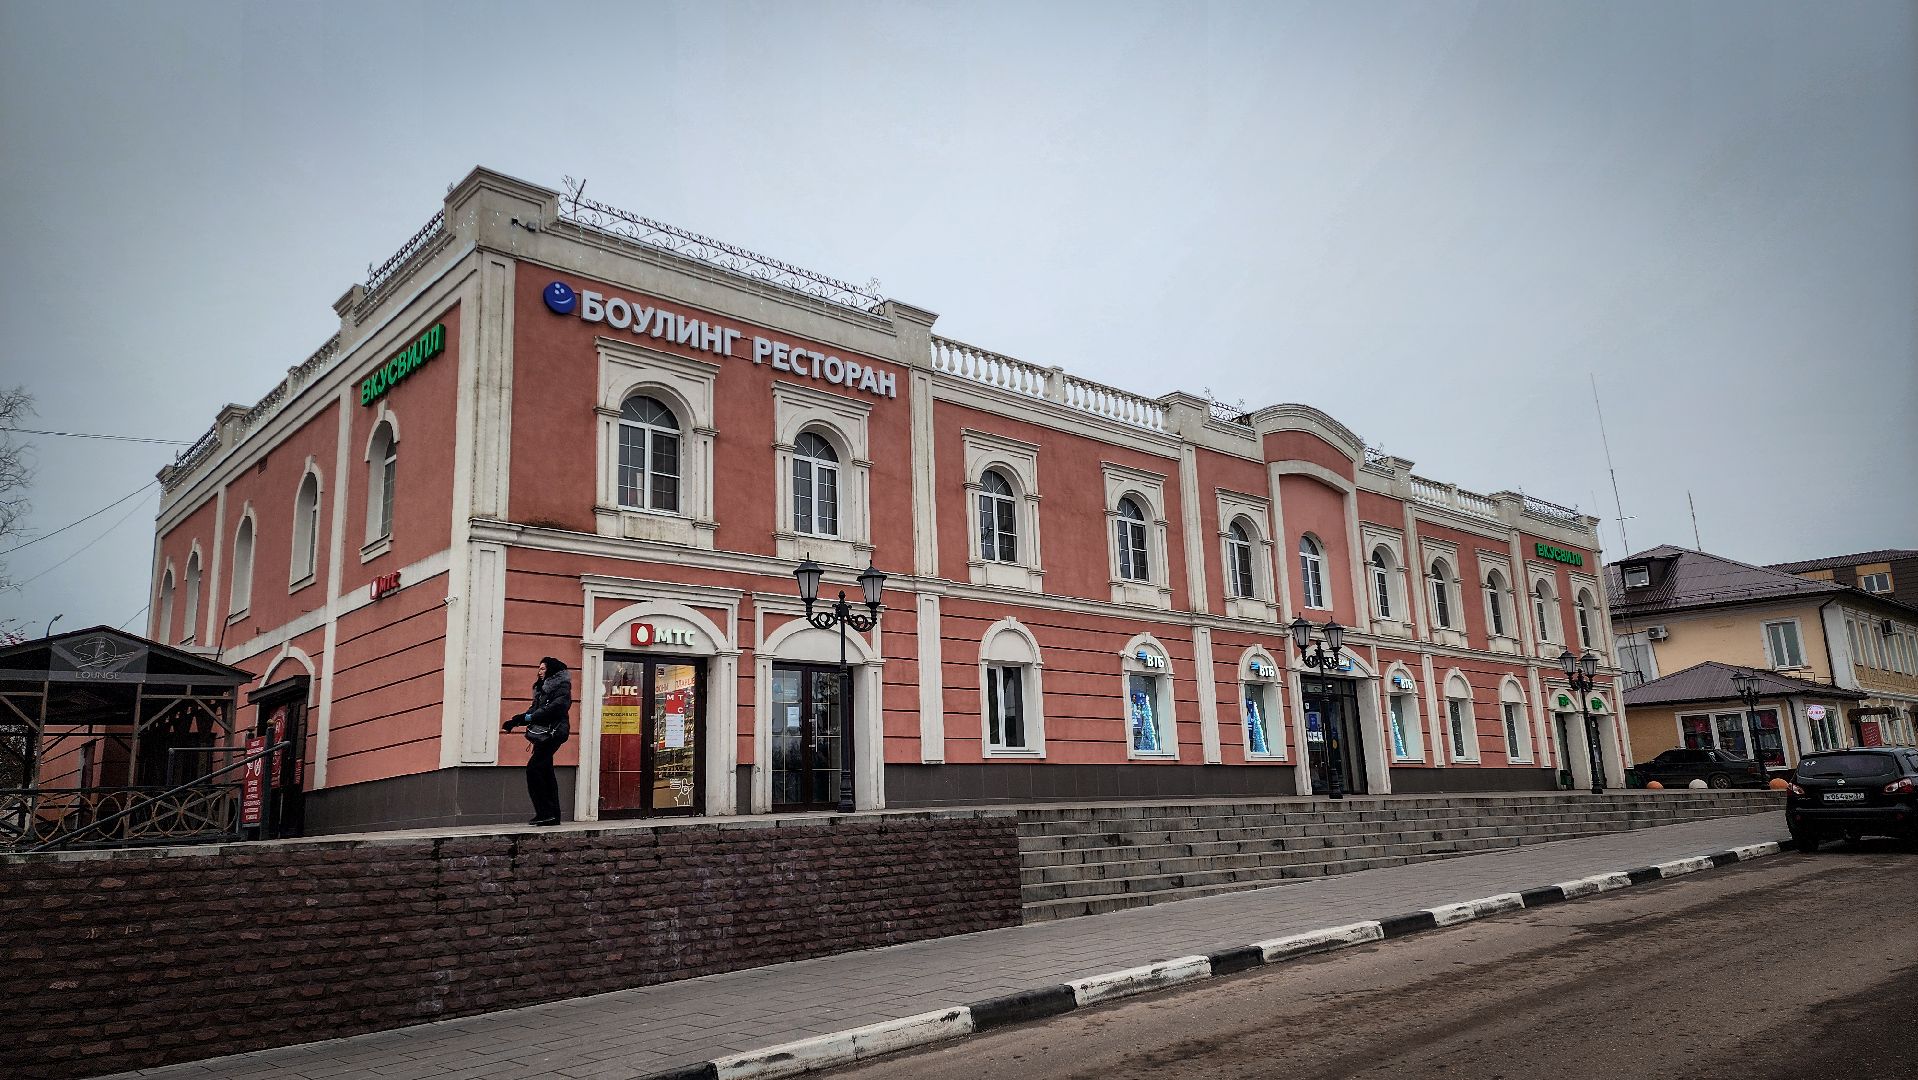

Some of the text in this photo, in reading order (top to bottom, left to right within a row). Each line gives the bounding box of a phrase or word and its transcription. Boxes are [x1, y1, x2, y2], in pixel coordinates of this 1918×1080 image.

[580, 289, 897, 398] БОУЛИНГ РЕСТОРАН
[361, 323, 444, 407] ВКУСВИЛЛ
[1536, 543, 1583, 567] ВКУСВИЛЛ
[655, 628, 696, 646] МТС
[1147, 655, 1165, 668] ВТБ
[75, 671, 121, 680] LOUNGE
[1259, 664, 1275, 677] ВТБ
[611, 685, 638, 696] МТС
[1401, 678, 1413, 690] ВТБ
